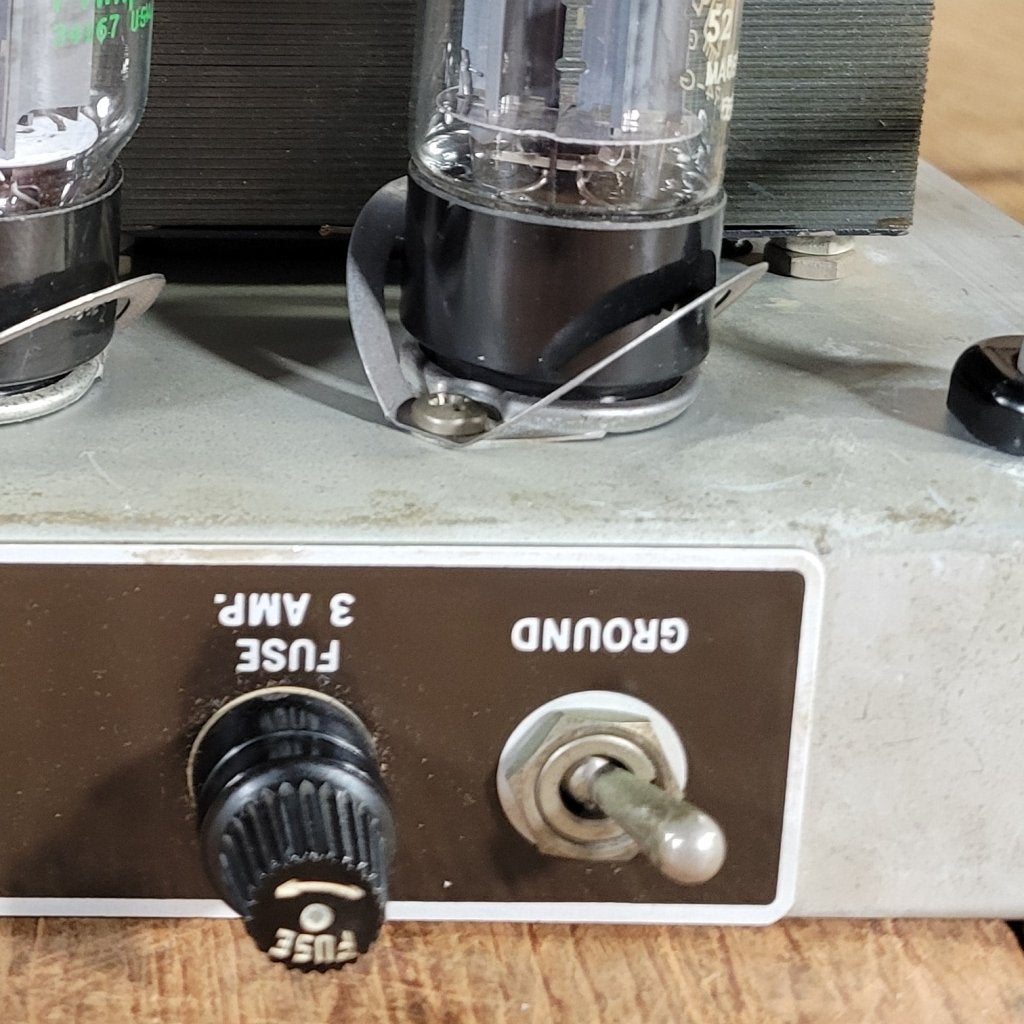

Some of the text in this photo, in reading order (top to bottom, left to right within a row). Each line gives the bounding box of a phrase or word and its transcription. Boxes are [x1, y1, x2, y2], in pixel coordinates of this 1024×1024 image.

[213, 592, 356, 628] 3 AMP.
[510, 616, 689, 654] GROUND
[235, 637, 340, 673] FUSE
[267, 927, 359, 966] FUSE
